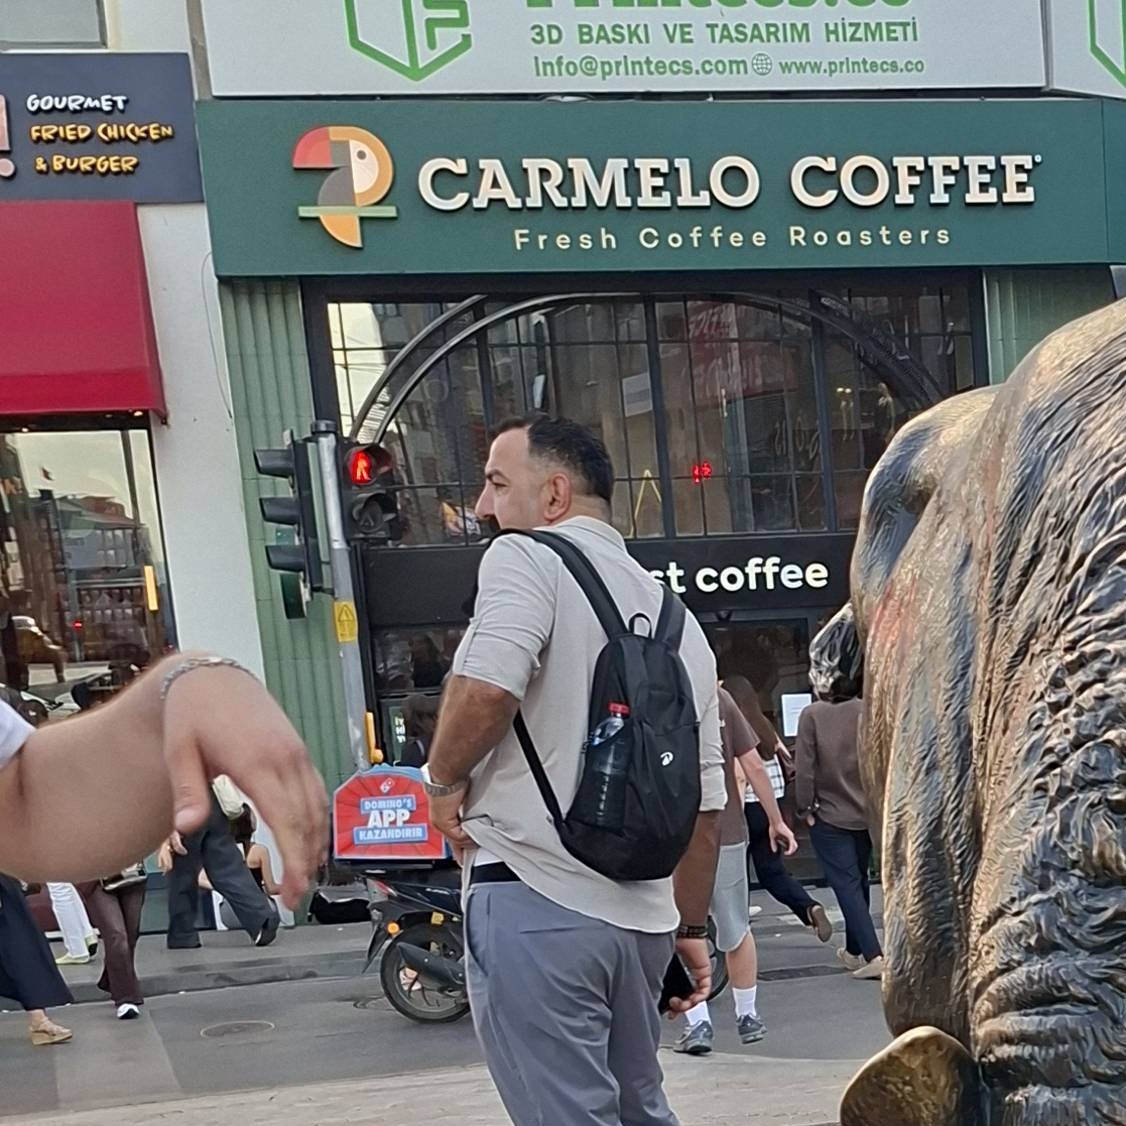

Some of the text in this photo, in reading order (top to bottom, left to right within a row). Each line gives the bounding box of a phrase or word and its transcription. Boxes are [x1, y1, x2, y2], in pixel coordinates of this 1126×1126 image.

[530, 17, 919, 44] 3D BASKI VE TASARIM HİZMETİ
[26, 94, 128, 112] GOURMET
[30, 122, 174, 142] FRIED CHICKEN
[35, 154, 139, 173] & BURGER
[418, 154, 760, 211] CARMELO
[514, 224, 951, 250] Fresh Coffee Roasters
[695, 556, 828, 593] coffee
[367, 808, 410, 829] APP
[359, 827, 423, 840] KAZANDIRIR
